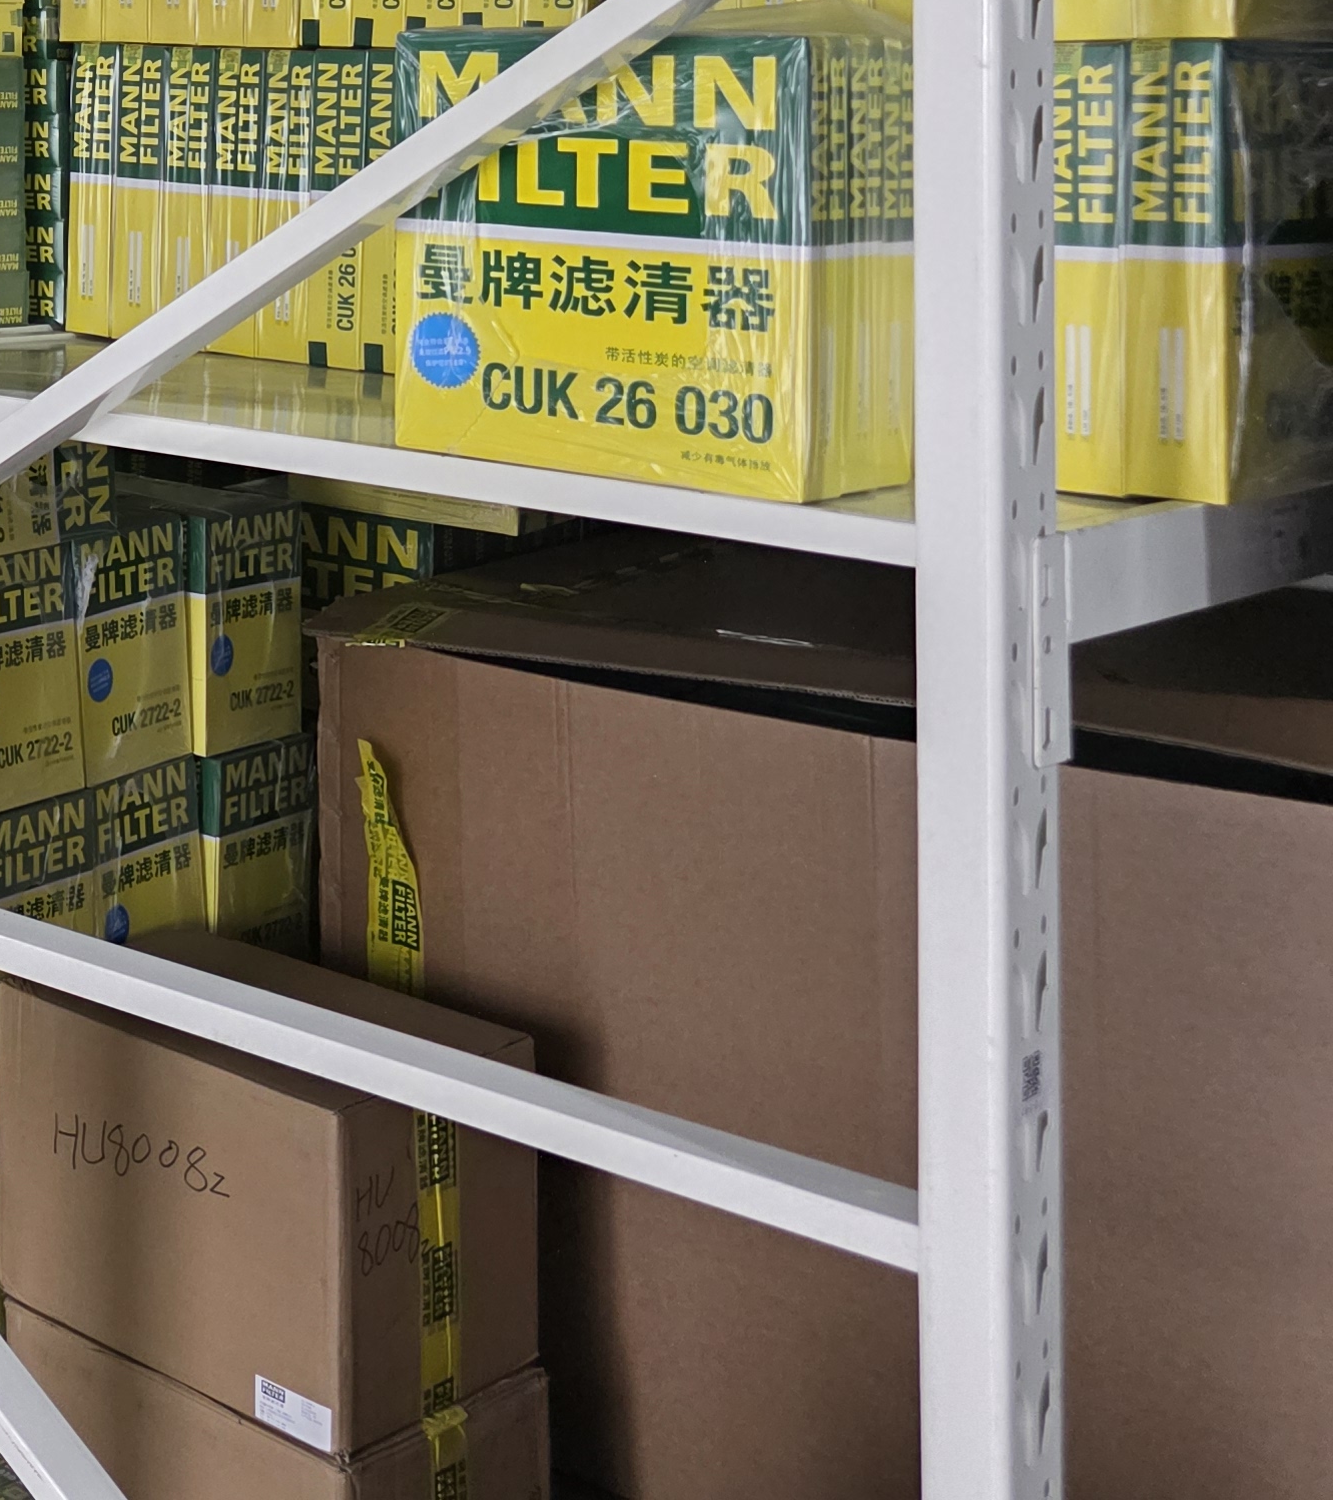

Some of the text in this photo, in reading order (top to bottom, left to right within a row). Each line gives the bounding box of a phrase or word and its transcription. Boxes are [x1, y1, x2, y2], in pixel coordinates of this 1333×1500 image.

[120, 61, 141, 162] MANN
[141, 59, 161, 163] FILTER
[418, 51, 777, 131] MNN
[432, 136, 778, 219] ILTER
[417, 244, 777, 331] 曼牌滤清器
[482, 362, 773, 444] CUK 26 030
[80, 522, 180, 574] MANN
[211, 509, 295, 543] MANN
[88, 554, 175, 601] FILTER
[211, 546, 294, 592] FILTER
[84, 603, 178, 652] 曼牌滤清器
[27, 732, 73, 760] 2722-2
[112, 699, 181, 737] CUK 2722-2
[102, 843, 192, 897] 曼牌滤清器
[393, 884, 405, 945] FILTER
[404, 886, 418, 949] MANN
